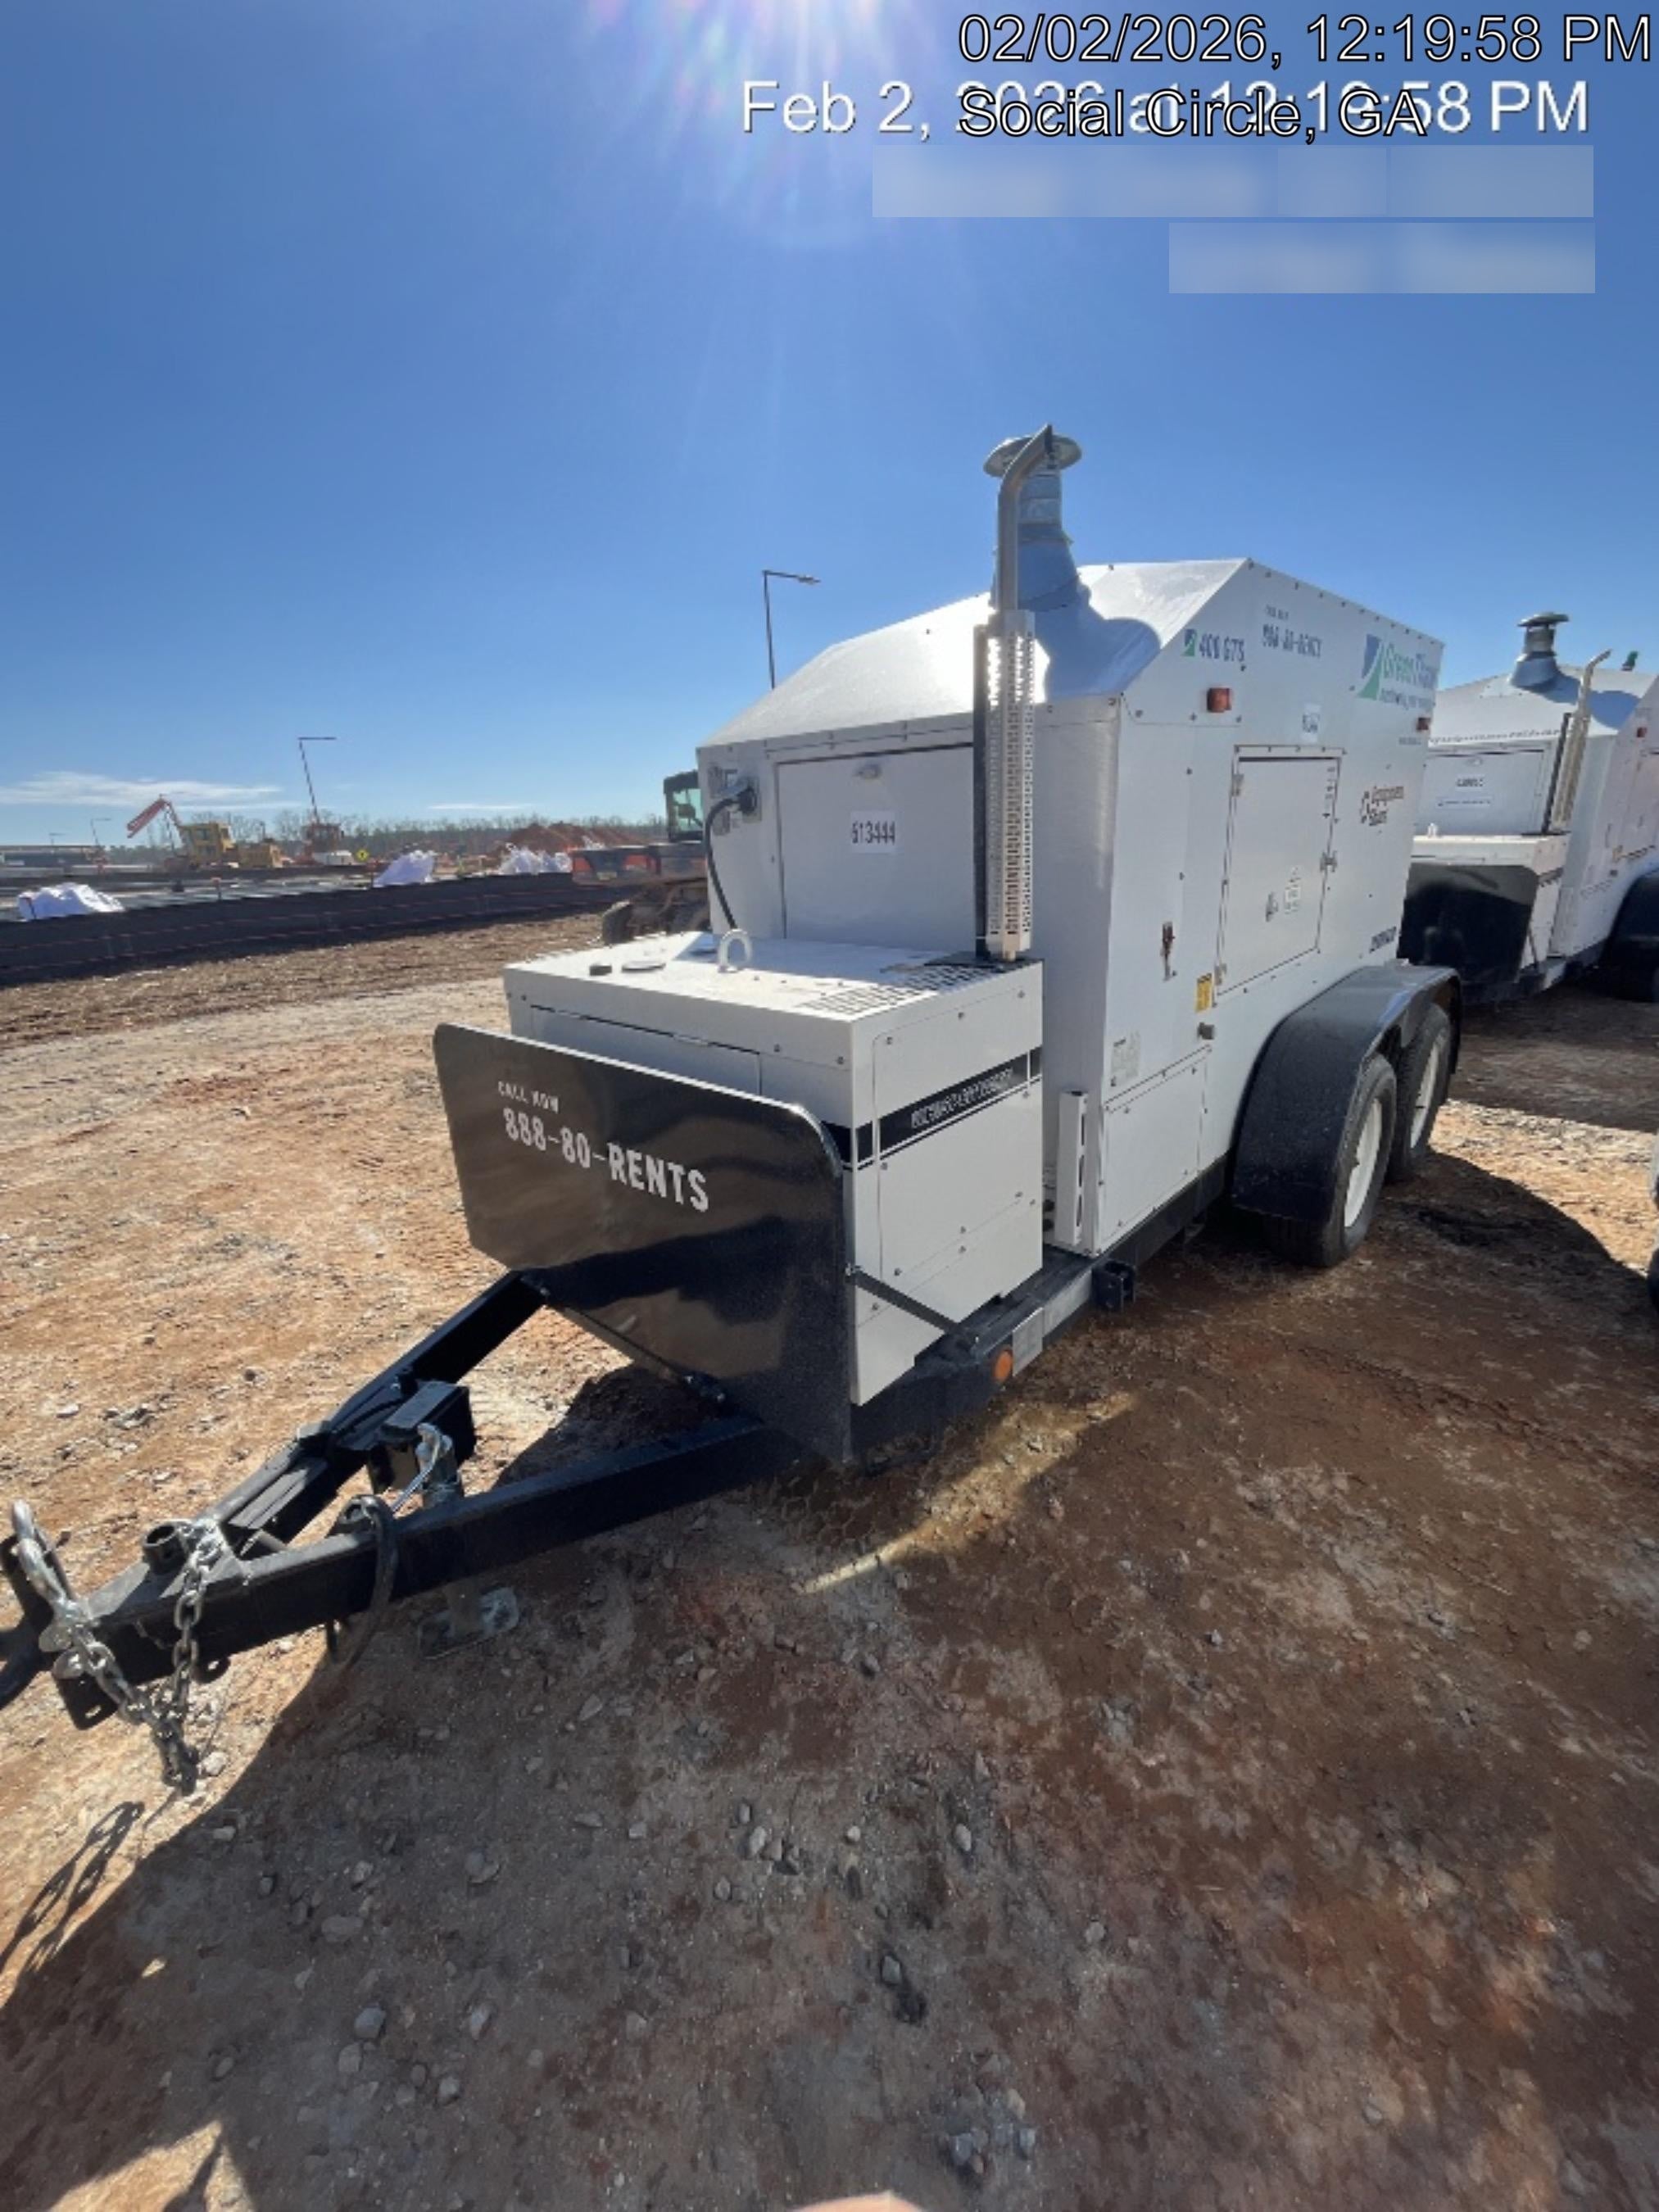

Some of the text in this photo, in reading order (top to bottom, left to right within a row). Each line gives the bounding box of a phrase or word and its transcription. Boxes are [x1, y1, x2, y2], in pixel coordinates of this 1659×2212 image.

[498, 1081, 559, 1114] CALL NOW
[503, 1108, 709, 1213] 888-80-RENTS
